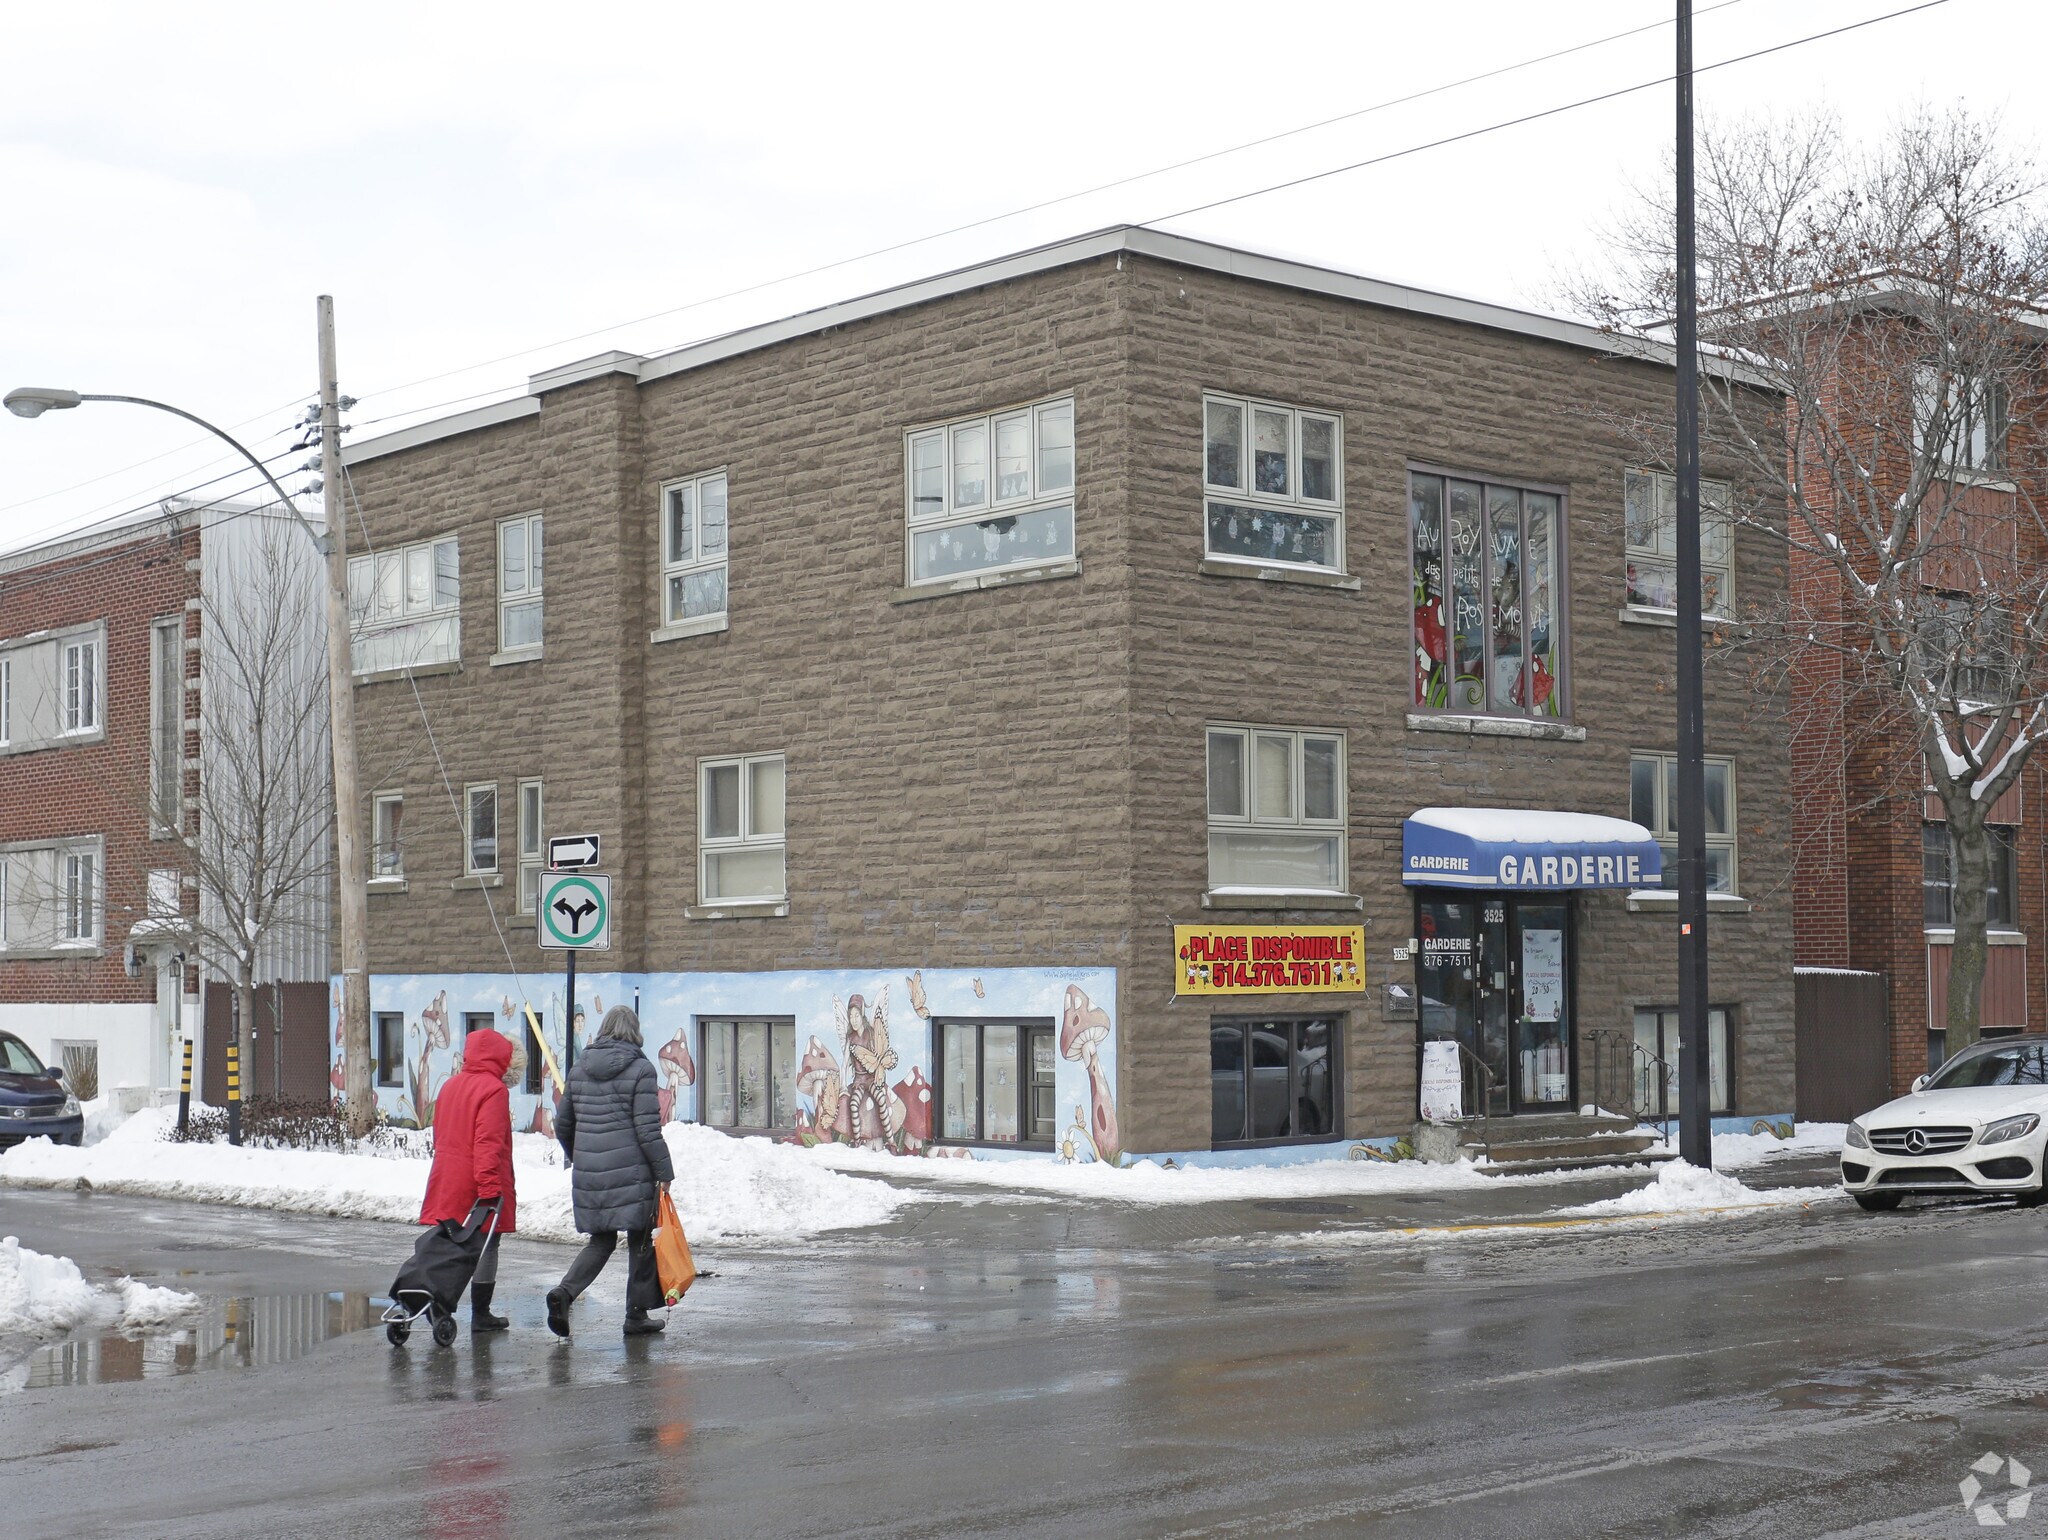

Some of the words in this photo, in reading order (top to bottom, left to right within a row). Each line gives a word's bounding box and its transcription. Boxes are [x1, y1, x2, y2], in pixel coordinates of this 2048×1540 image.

[1417, 519, 1440, 548] AU
[1453, 564, 1479, 588] petits
[1410, 855, 1469, 871] GARDERIE
[1500, 855, 1640, 885] GARDERIE
[1484, 909, 1504, 923] 3525
[1189, 936, 1248, 961] PLACE
[1251, 936, 1352, 961] DISPONIBLE
[1424, 938, 1471, 950] GARDERIE
[1212, 962, 1331, 987] 514.376.7511
